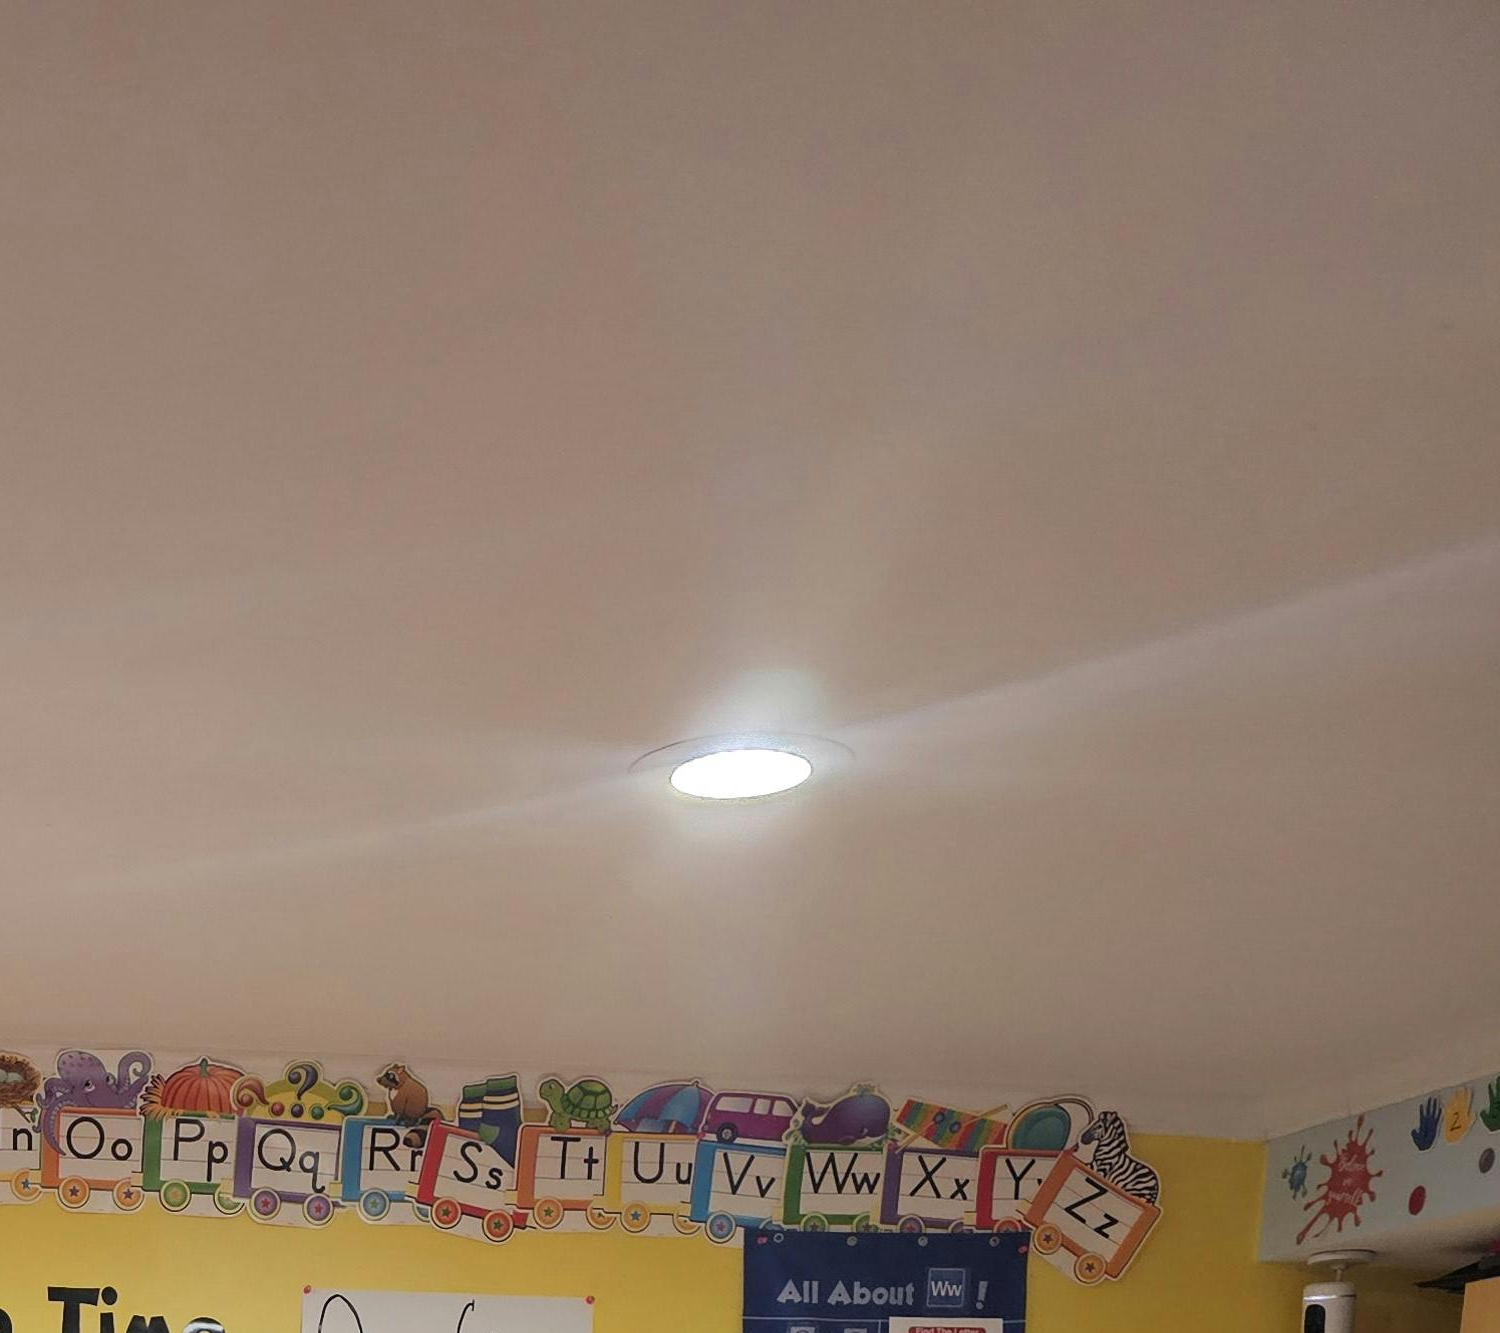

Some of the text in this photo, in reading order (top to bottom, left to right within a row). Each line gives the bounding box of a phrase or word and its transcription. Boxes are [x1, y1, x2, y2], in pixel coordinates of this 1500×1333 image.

[1449, 1111, 1463, 1133] 2
[65, 1116, 132, 1162] Oo
[256, 1128, 326, 1194] Qq
[452, 1140, 503, 1191] Ss
[632, 1141, 693, 1185] Uu
[805, 1150, 881, 1196] Ww
[908, 1154, 970, 1202] Xx
[1064, 1176, 1121, 1240] Zz
[775, 1279, 963, 1306] All About Ww
